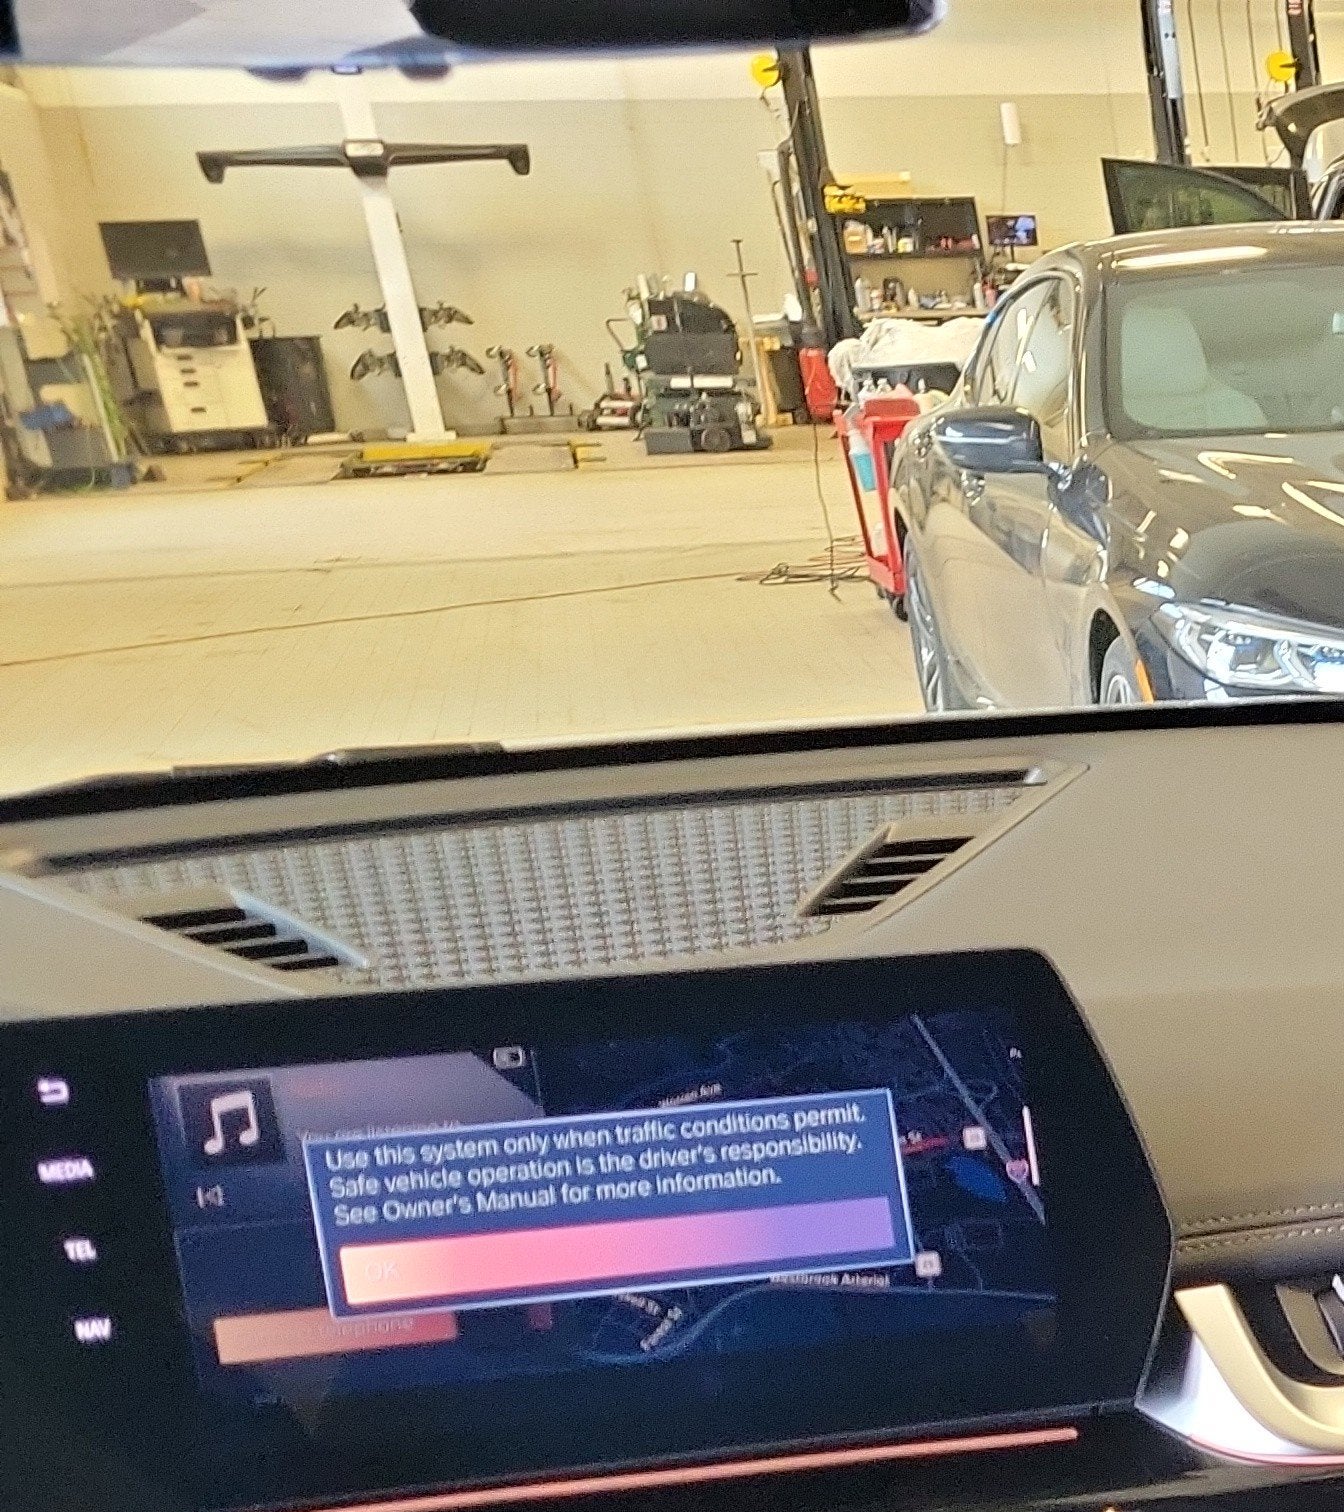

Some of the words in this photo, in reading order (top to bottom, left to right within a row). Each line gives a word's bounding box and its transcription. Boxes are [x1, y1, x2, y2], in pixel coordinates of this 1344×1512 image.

[325, 1150, 369, 1171] Use
[374, 1145, 416, 1167] this
[420, 1138, 498, 1164] system
[503, 1131, 549, 1156] only
[553, 1126, 610, 1150] when
[615, 1119, 675, 1145] traffic
[680, 1110, 789, 1138] conditions
[793, 1102, 865, 1132] permit.
[37, 1157, 95, 1183] MEDIA
[329, 1175, 379, 1198] Safe
[384, 1168, 461, 1193] vehicle
[467, 1157, 571, 1188] operation
[576, 1154, 594, 1175] is
[600, 1149, 635, 1173] the
[639, 1143, 718, 1169] driver's
[720, 1131, 862, 1163] responsibility.
[333, 1204, 378, 1226] See
[382, 1194, 472, 1220] Owner's
[476, 1186, 557, 1213] Manual
[561, 1182, 591, 1204] for
[596, 1178, 651, 1202] more
[656, 1165, 781, 1195] information.
[63, 1238, 97, 1262] TEL
[364, 1261, 401, 1282] OK
[74, 1317, 111, 1341] NAV
